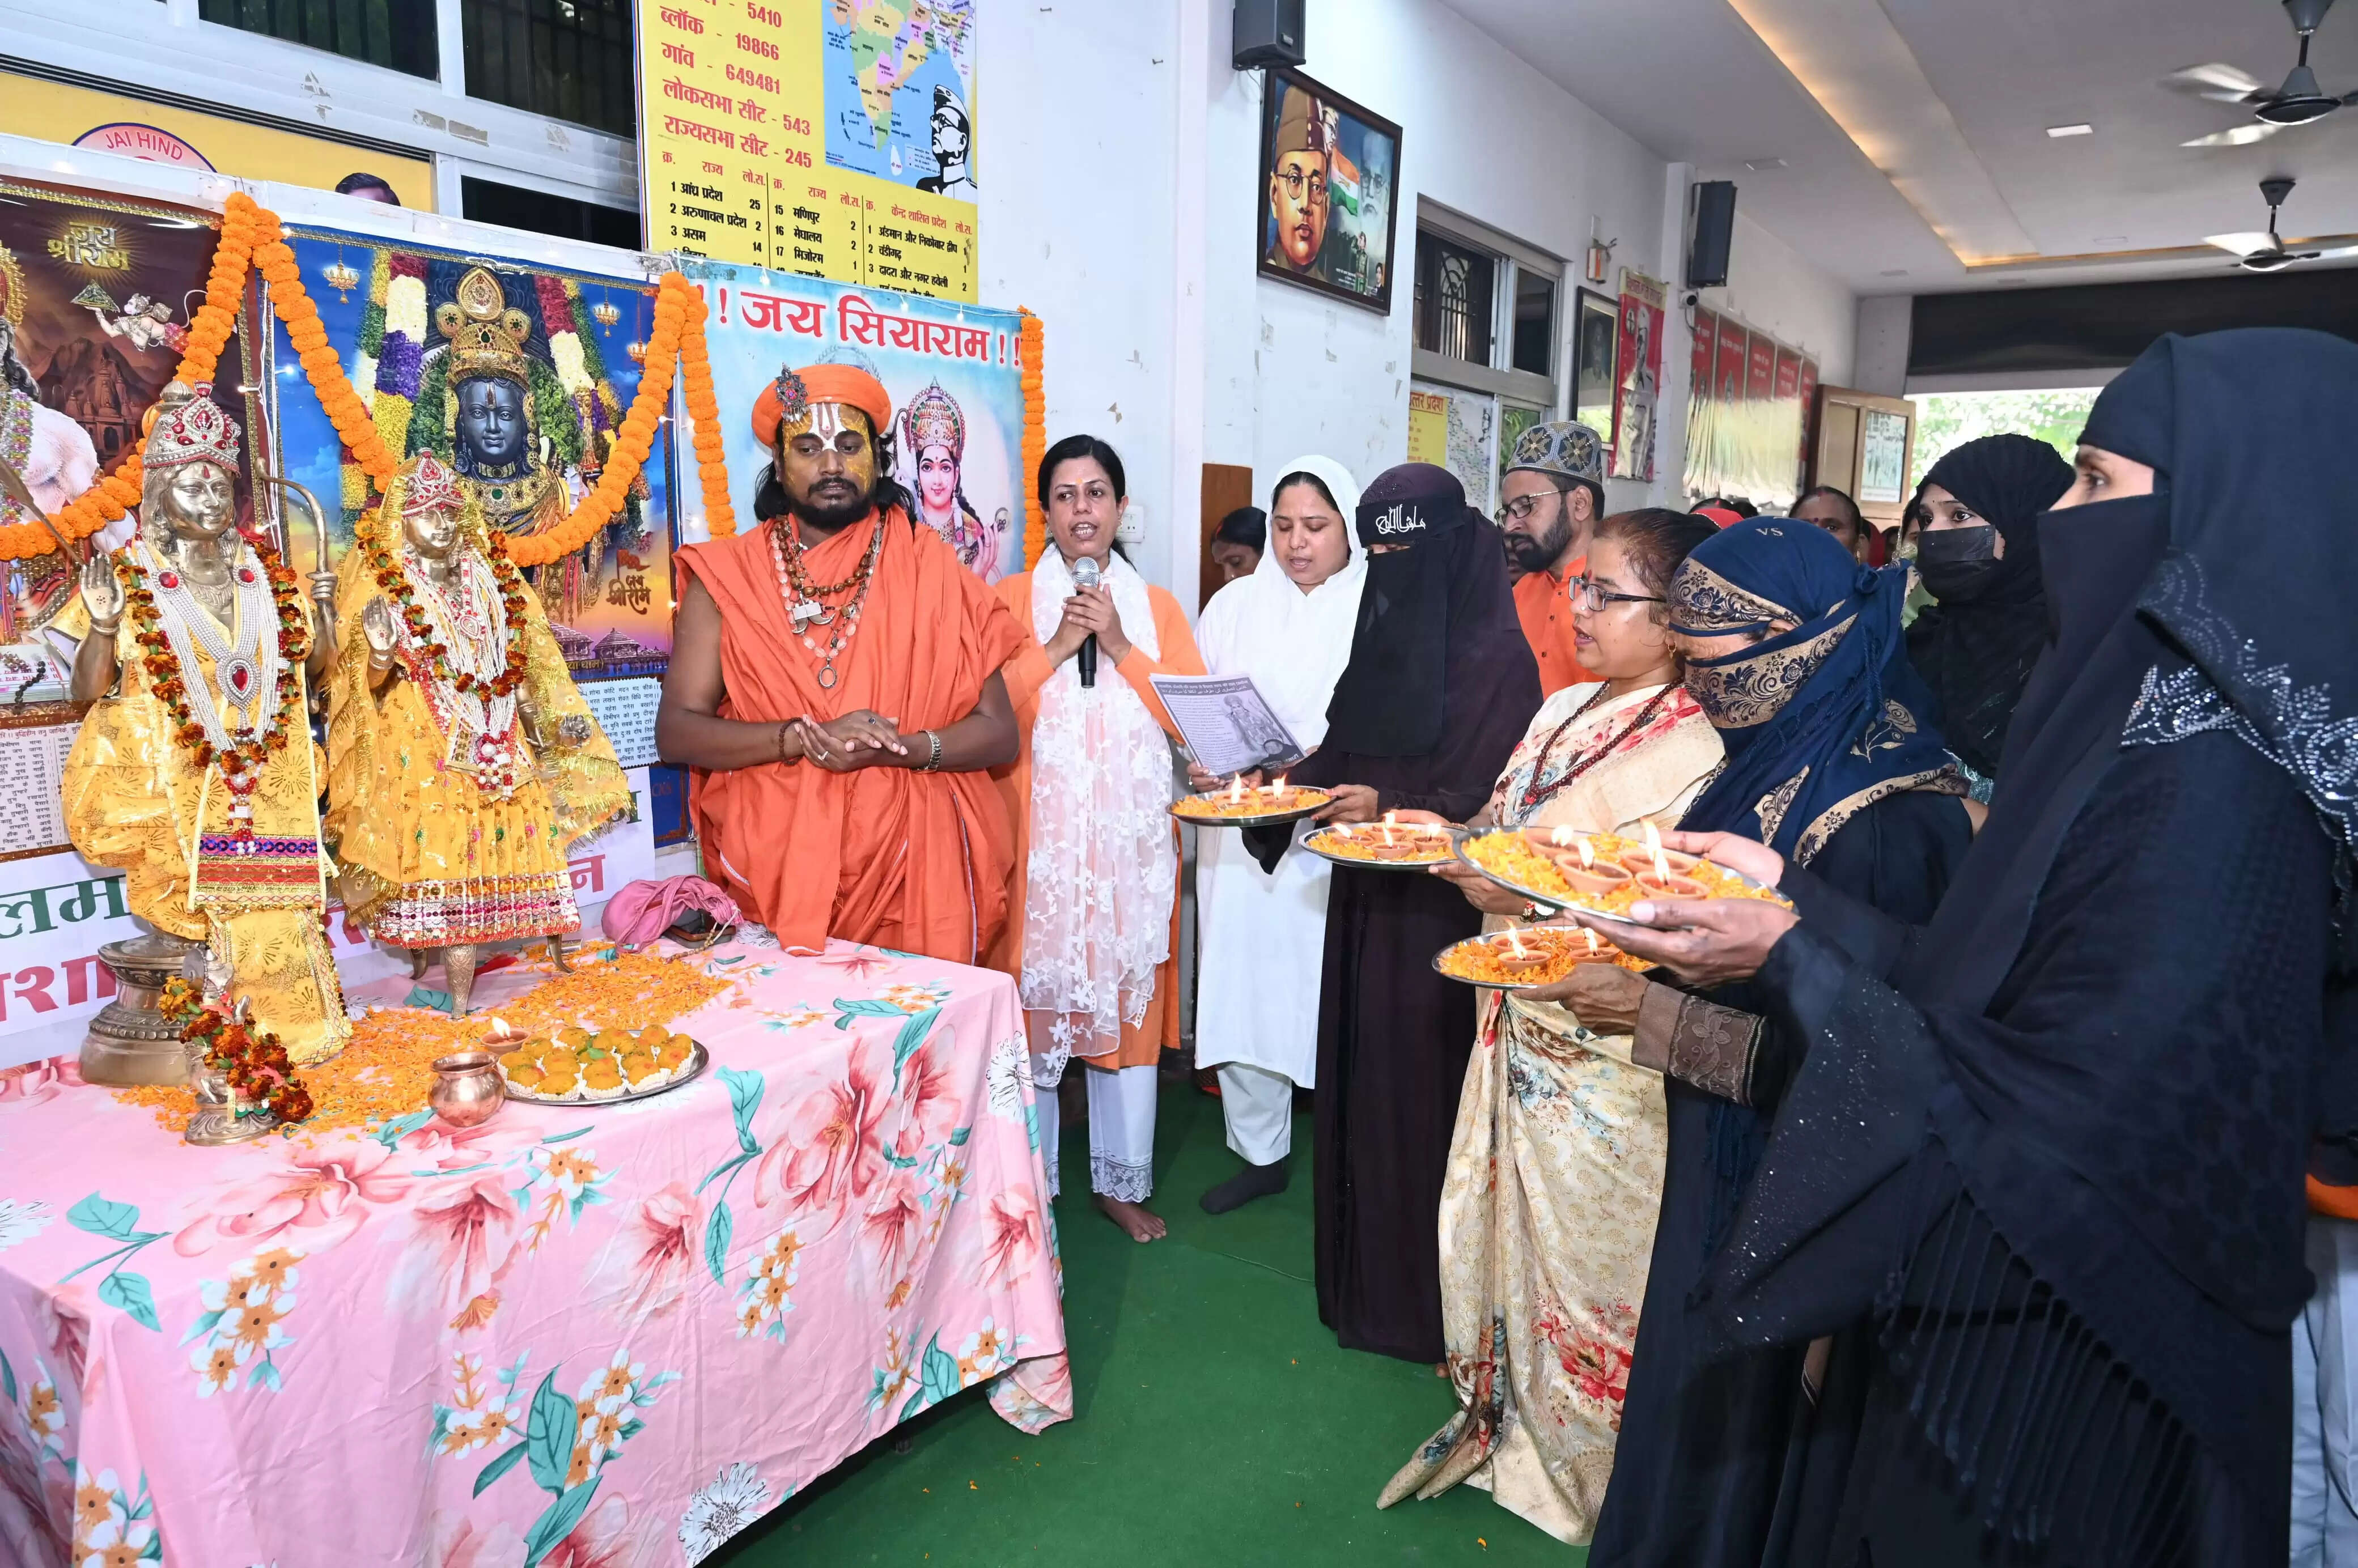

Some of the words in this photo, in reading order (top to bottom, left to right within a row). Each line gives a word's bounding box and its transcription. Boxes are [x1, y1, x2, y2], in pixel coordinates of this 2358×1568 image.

[748, 2, 782, 28] 5410
[660, 6, 704, 35] ब्लॉक
[735, 33, 779, 60] 19866
[661, 42, 694, 68] गांव
[726, 64, 780, 95] 649481
[662, 76, 732, 114] लोकसभा
[737, 99, 766, 123] सीट
[783, 114, 811, 136] 543
[105, 131, 132, 149] JAI
[136, 131, 183, 160] HIND
[664, 114, 735, 149] राज्यसभा
[739, 133, 769, 157] सीट
[785, 148, 812, 168] 245
[662, 151, 675, 164] क्र.
[702, 161, 723, 176] राज्य
[671, 181, 676, 192] 1
[680, 182, 699, 197] आंध्र
[702, 185, 723, 202] प्रदेश
[749, 199, 761, 210] 25
[773, 178, 785, 190] क्र.
[808, 186, 826, 199] राज्य
[670, 203, 676, 214] 2
[681, 205, 724, 224] अरुणाचल
[727, 212, 747, 228] प्रदेश
[756, 221, 761, 231] 2
[774, 204, 783, 215] 15
[792, 206, 820, 225] मणिपुर
[851, 221, 856, 231] 2
[891, 204, 906, 219] केन्द्र
[908, 210, 930, 225] शासित
[931, 215, 947, 229] प्रदेश
[69, 222, 117, 248] जय
[671, 225, 677, 236] 3
[682, 227, 706, 241] असम
[753, 241, 762, 252] 14
[775, 225, 784, 236] 16
[794, 226, 822, 244] मेघालय
[851, 240, 856, 250] 2
[868, 224, 871, 233] 1
[879, 225, 902, 240] अंडमान
[905, 230, 917, 244] और
[919, 233, 945, 250] निकोबार
[947, 240, 957, 253] द्वीप
[868, 244, 873, 253] 2
[776, 246, 784, 256] 17
[794, 247, 824, 264] मिजोरम
[853, 261, 856, 270] 1
[869, 264, 873, 273] 3
[879, 265, 897, 278] दादरा
[900, 266, 911, 281] और
[914, 272, 930, 284] नगर
[931, 274, 948, 288] हवेली
[962, 283, 966, 291] 2
[740, 291, 826, 338] जय
[837, 295, 990, 362] सियाराम
[1755, 527, 1783, 537] VS
[626, 575, 645, 588] जय
